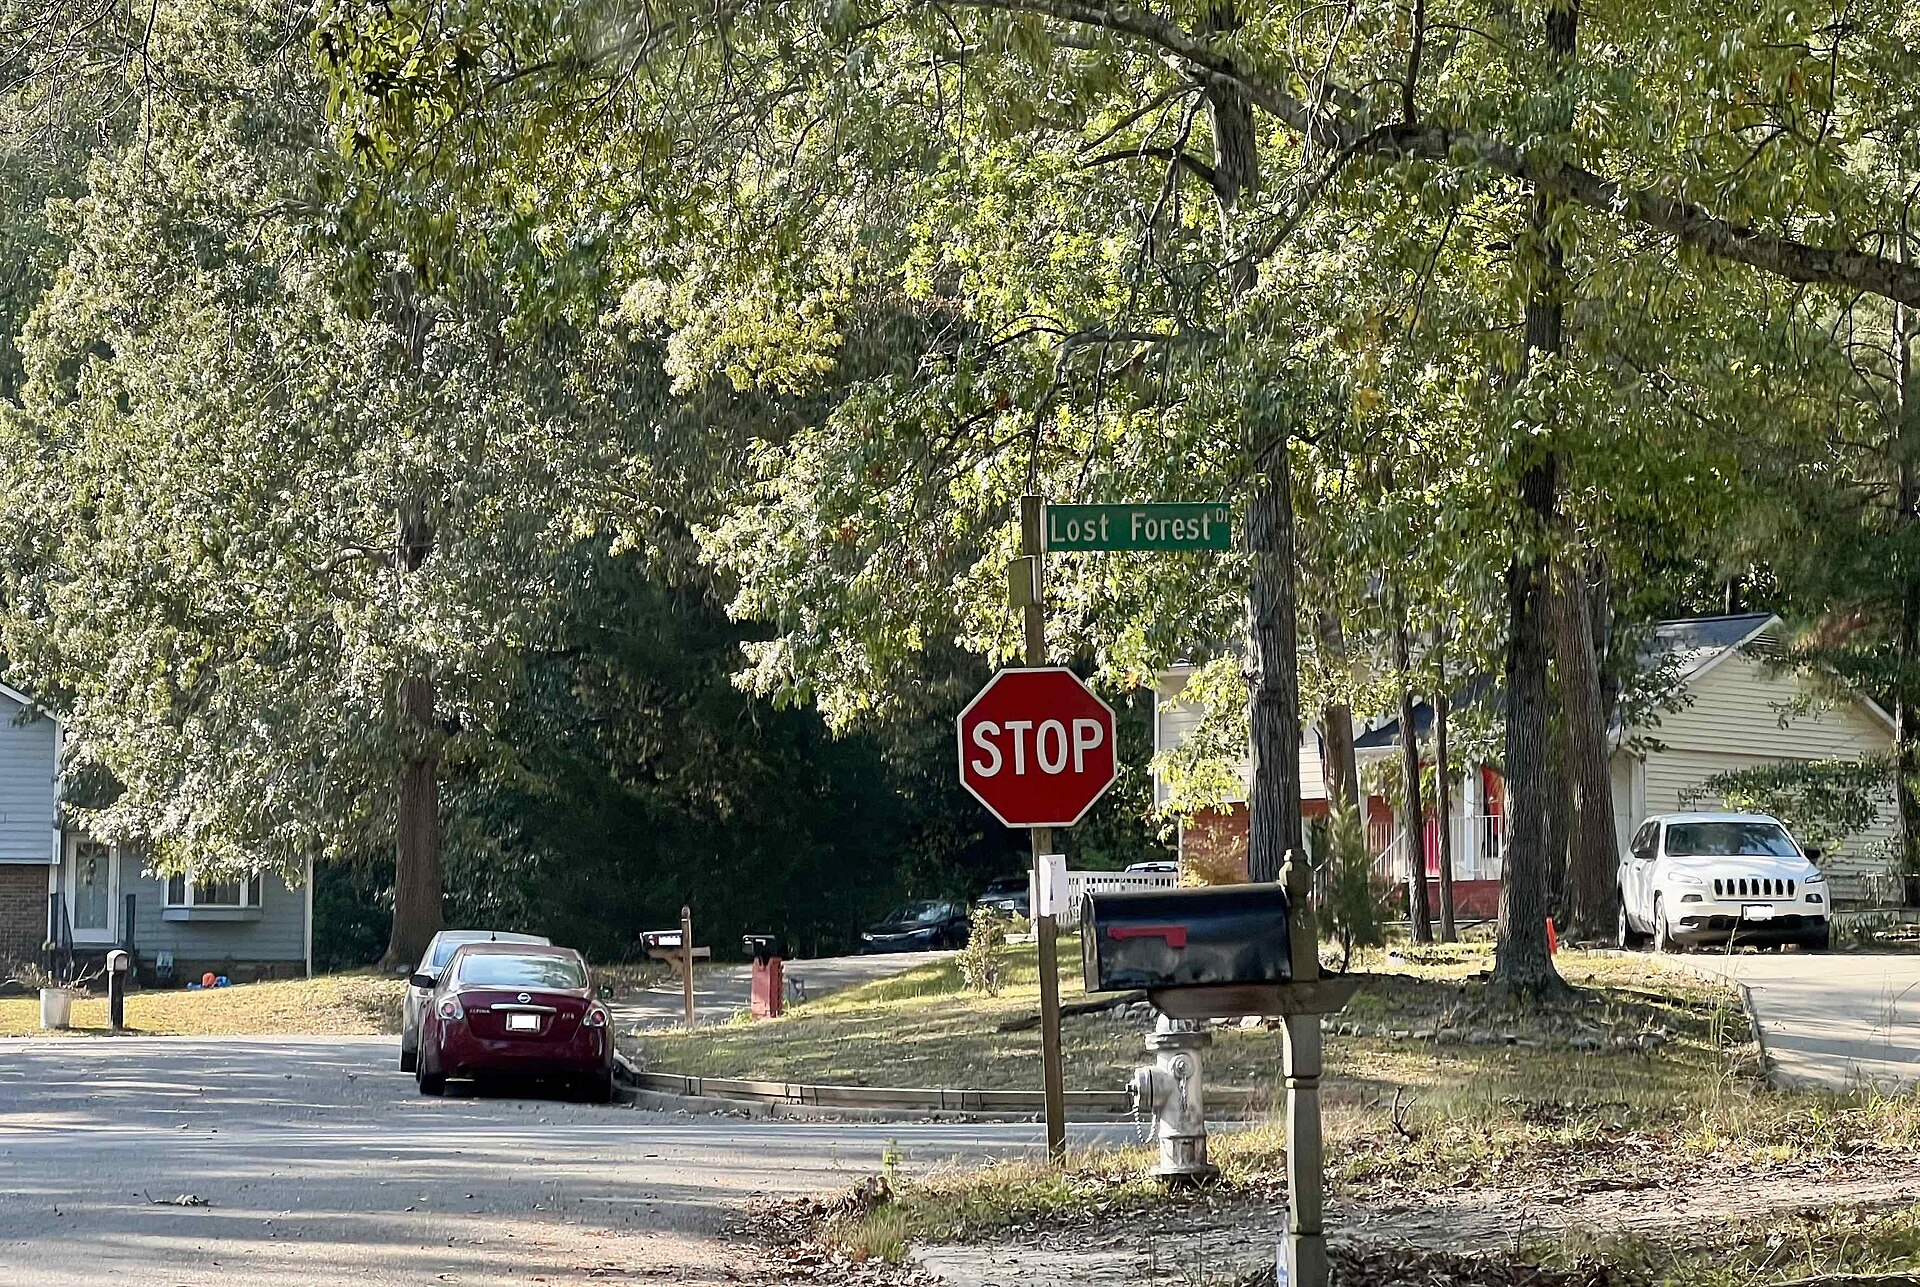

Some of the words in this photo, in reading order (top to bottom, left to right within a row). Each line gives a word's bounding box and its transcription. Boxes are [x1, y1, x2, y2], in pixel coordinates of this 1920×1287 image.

[1051, 512, 1109, 543] Lost
[1131, 512, 1211, 542] Forest
[1216, 507, 1229, 523] Dr
[971, 718, 1104, 778] STOP
